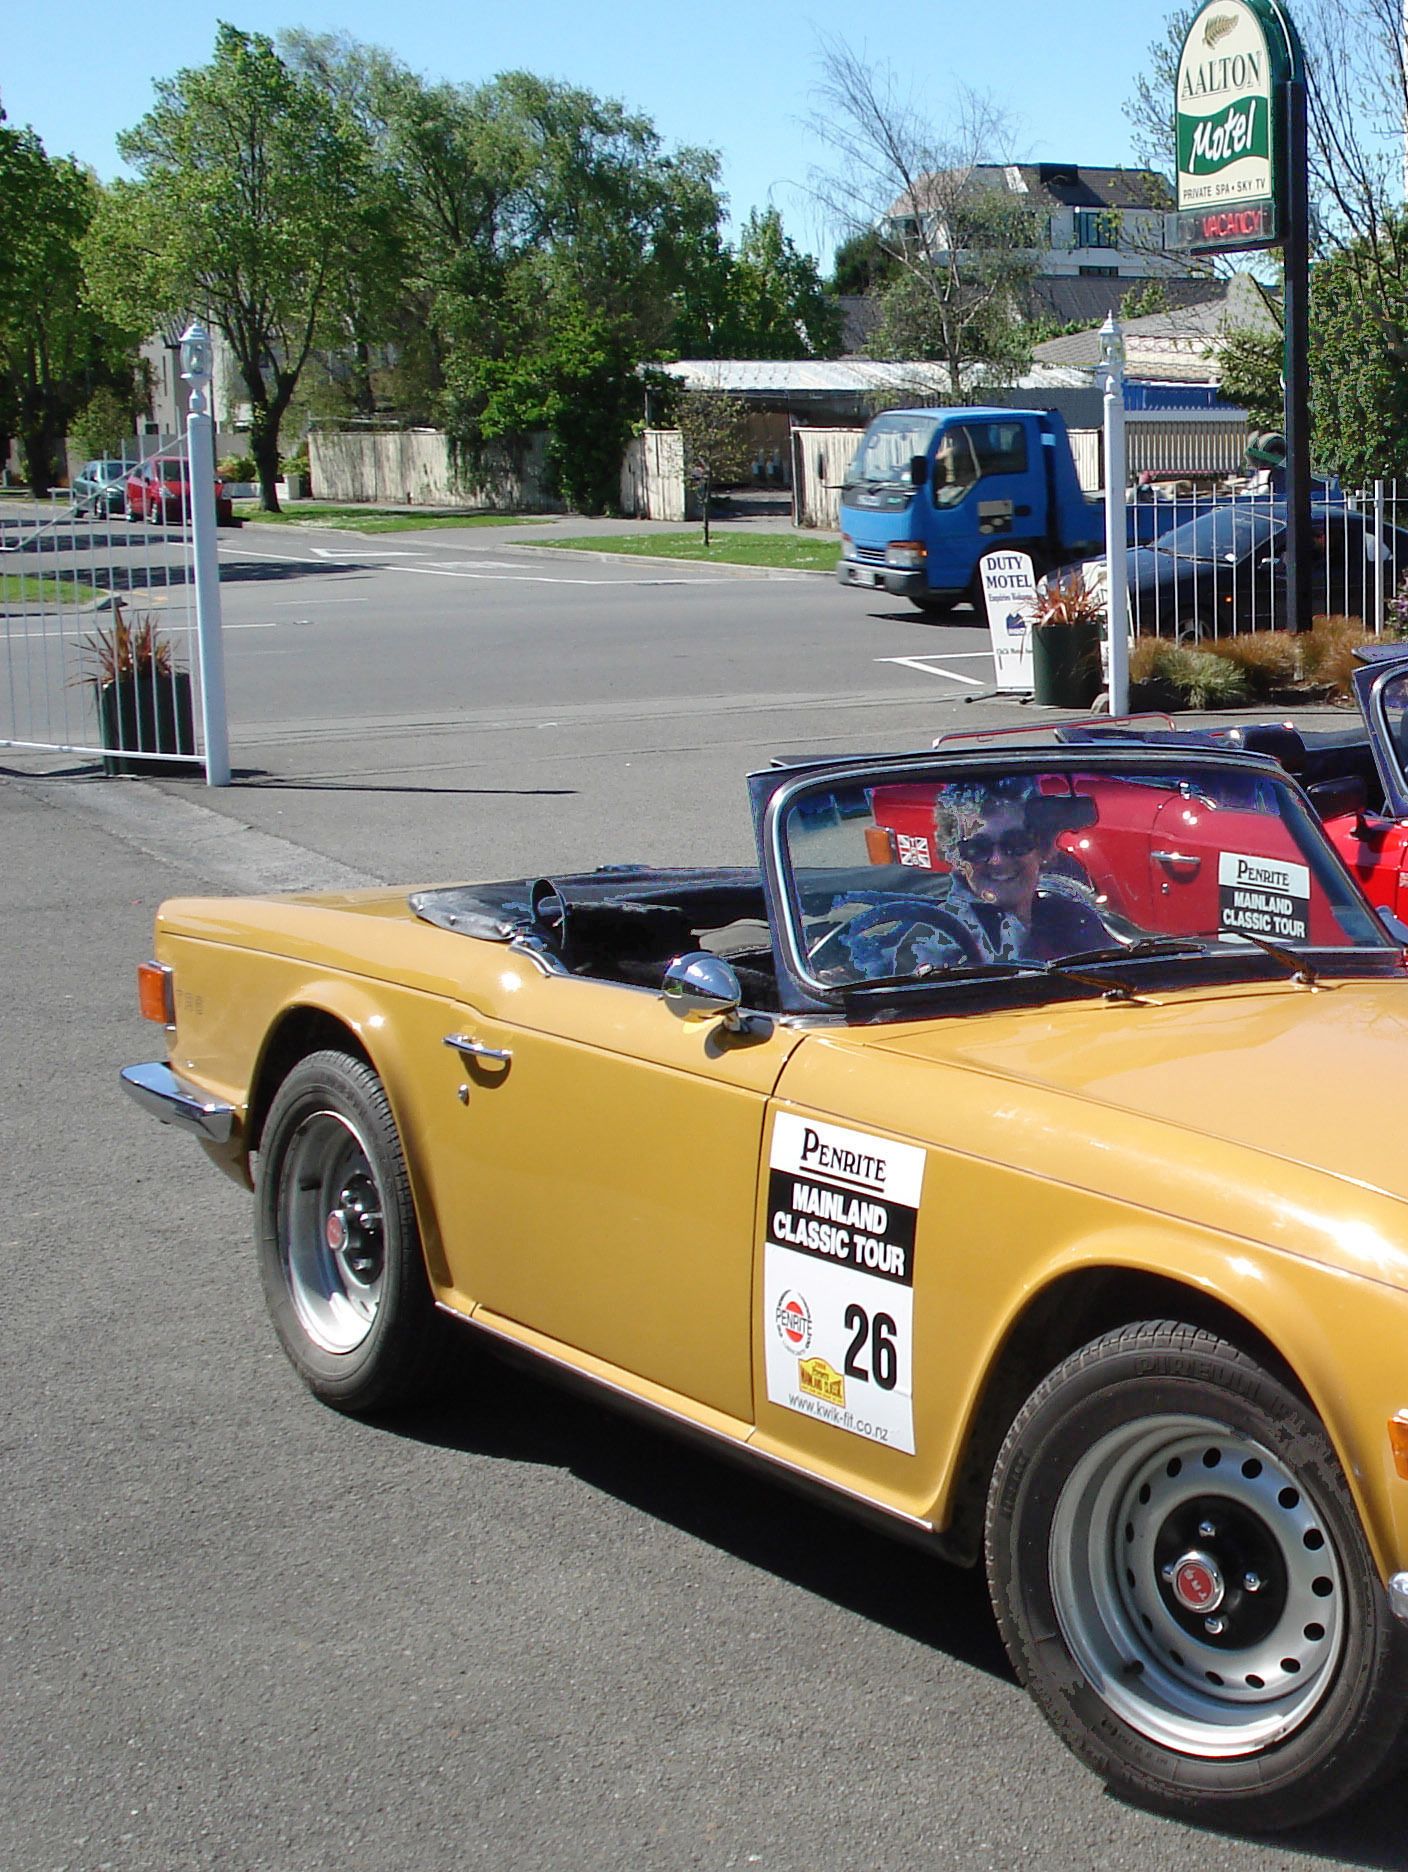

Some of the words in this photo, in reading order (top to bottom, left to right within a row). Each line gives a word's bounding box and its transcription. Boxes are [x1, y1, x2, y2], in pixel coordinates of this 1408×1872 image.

[1181, 51, 1262, 98] AALTON
[1188, 99, 1257, 174] Motel
[1183, 185, 1213, 200] PRIVATE
[1215, 183, 1230, 195] SPA
[1237, 180, 1253, 193] SKY
[1255, 178, 1266, 189] TV
[1202, 210, 1261, 238] VACANCY
[986, 556, 1023, 571] DUTY
[986, 574, 1033, 589] MOTEL
[1236, 859, 1290, 887] PENRITE
[1233, 891, 1293, 916] MAINLAND
[1222, 908, 1273, 932] CLASSIC
[1273, 917, 1306, 938] TOUR
[800, 1127, 888, 1183] PENRITE
[792, 1182, 888, 1236] MAINLAND
[772, 1210, 850, 1259] CLASSIC
[853, 1235, 905, 1277] TOUR
[775, 1306, 813, 1337] PENRITE
[843, 1303, 898, 1391] 26
